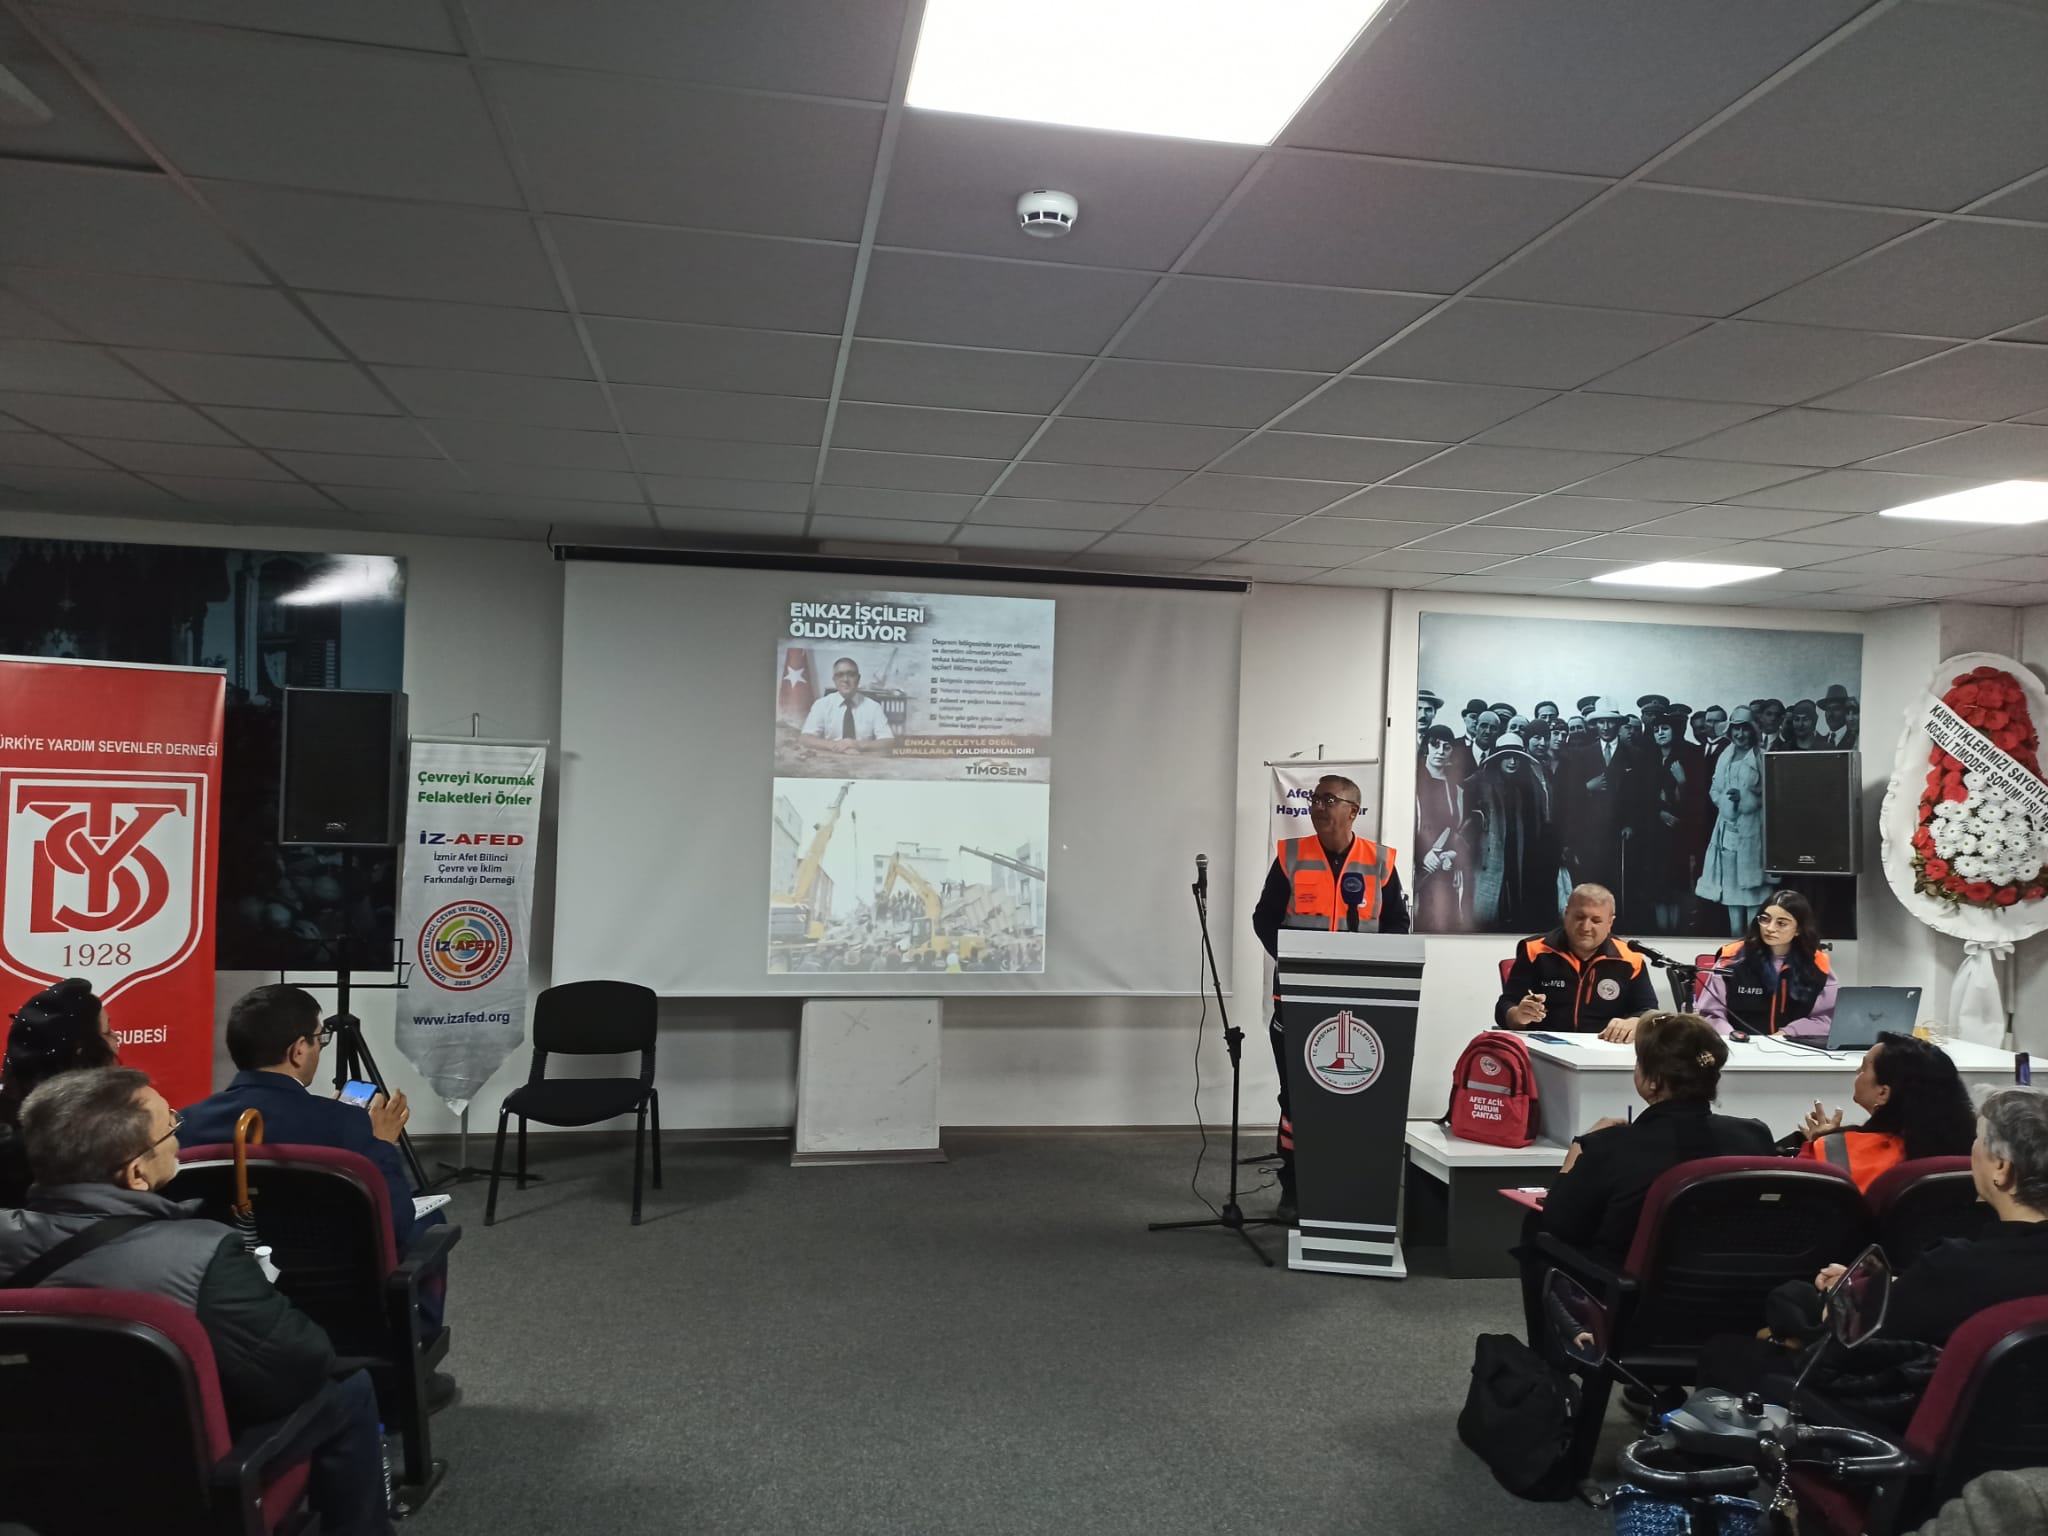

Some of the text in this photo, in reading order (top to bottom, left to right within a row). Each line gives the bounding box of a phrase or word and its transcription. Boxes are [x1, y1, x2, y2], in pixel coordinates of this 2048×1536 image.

[790, 602, 925, 624] ENKAZ İŞÇİLERİ
[789, 618, 907, 641] ÖLDÜRÜYOR
[0, 734, 218, 757] ÜRKİYE YARDIM SEVENLER DERNEĞİ
[1949, 742, 1991, 776] TİMODER
[965, 763, 1027, 776] TİMOSEN
[417, 771, 536, 786] Çevreyi Korumak
[417, 790, 533, 805] Felaketleri Önler
[419, 830, 524, 846] İZ-AFED
[433, 851, 508, 861] İzmir Afet Bilinci
[438, 864, 464, 874] Çevre
[480, 863, 502, 873] İklim
[423, 875, 515, 886] Farkındalığı Derneği
[62, 942, 132, 967] 1928
[412, 1011, 511, 1026] www.izafed.org
[1469, 1096, 1504, 1107] AFET ACİL
[1473, 1103, 1499, 1113] DURUM
[1471, 1110, 1502, 1120] ÇANTASI
